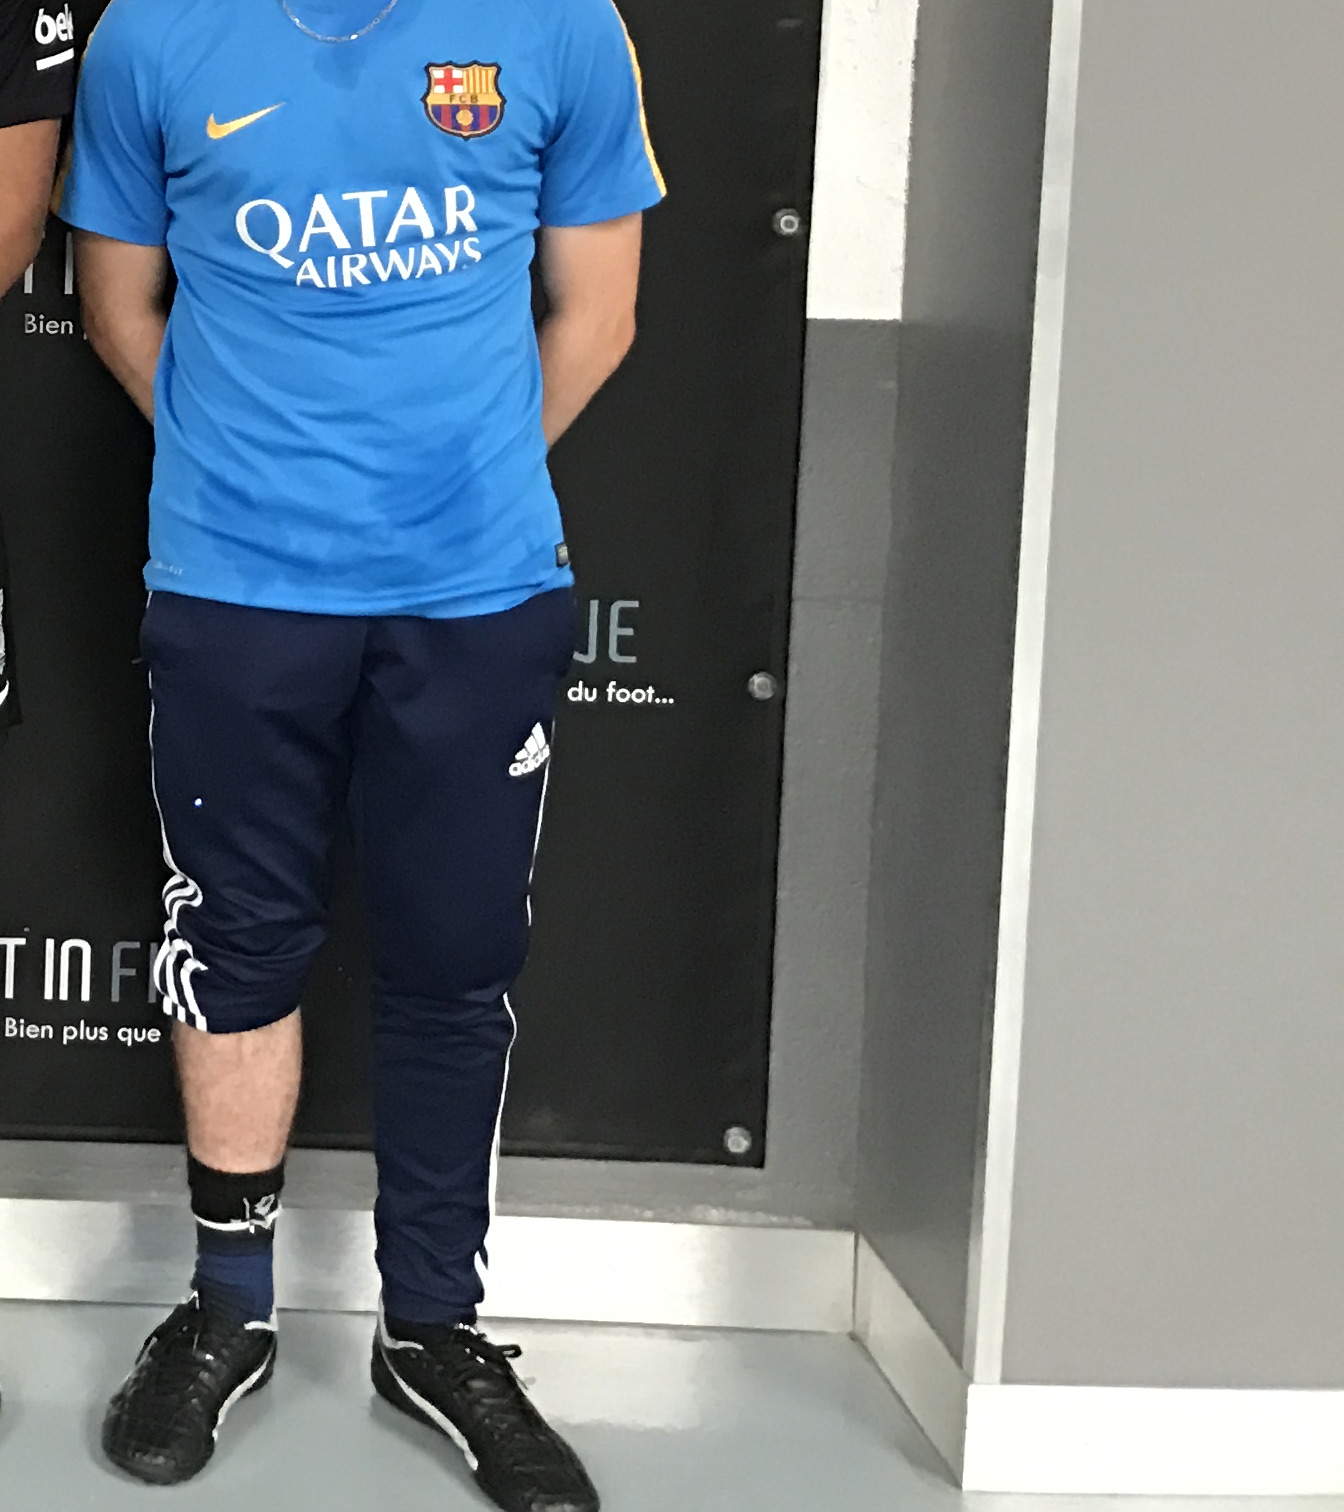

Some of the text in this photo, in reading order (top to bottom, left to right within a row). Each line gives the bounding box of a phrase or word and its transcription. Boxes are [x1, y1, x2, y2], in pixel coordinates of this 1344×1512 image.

[235, 184, 478, 269] QATAR
[296, 237, 482, 288] AIRWAYS
[24, 313, 74, 335] Bien
[567, 681, 675, 705] du foot...
[43, 937, 92, 1002] IN
[4, 1017, 162, 1047] Bien plus que
